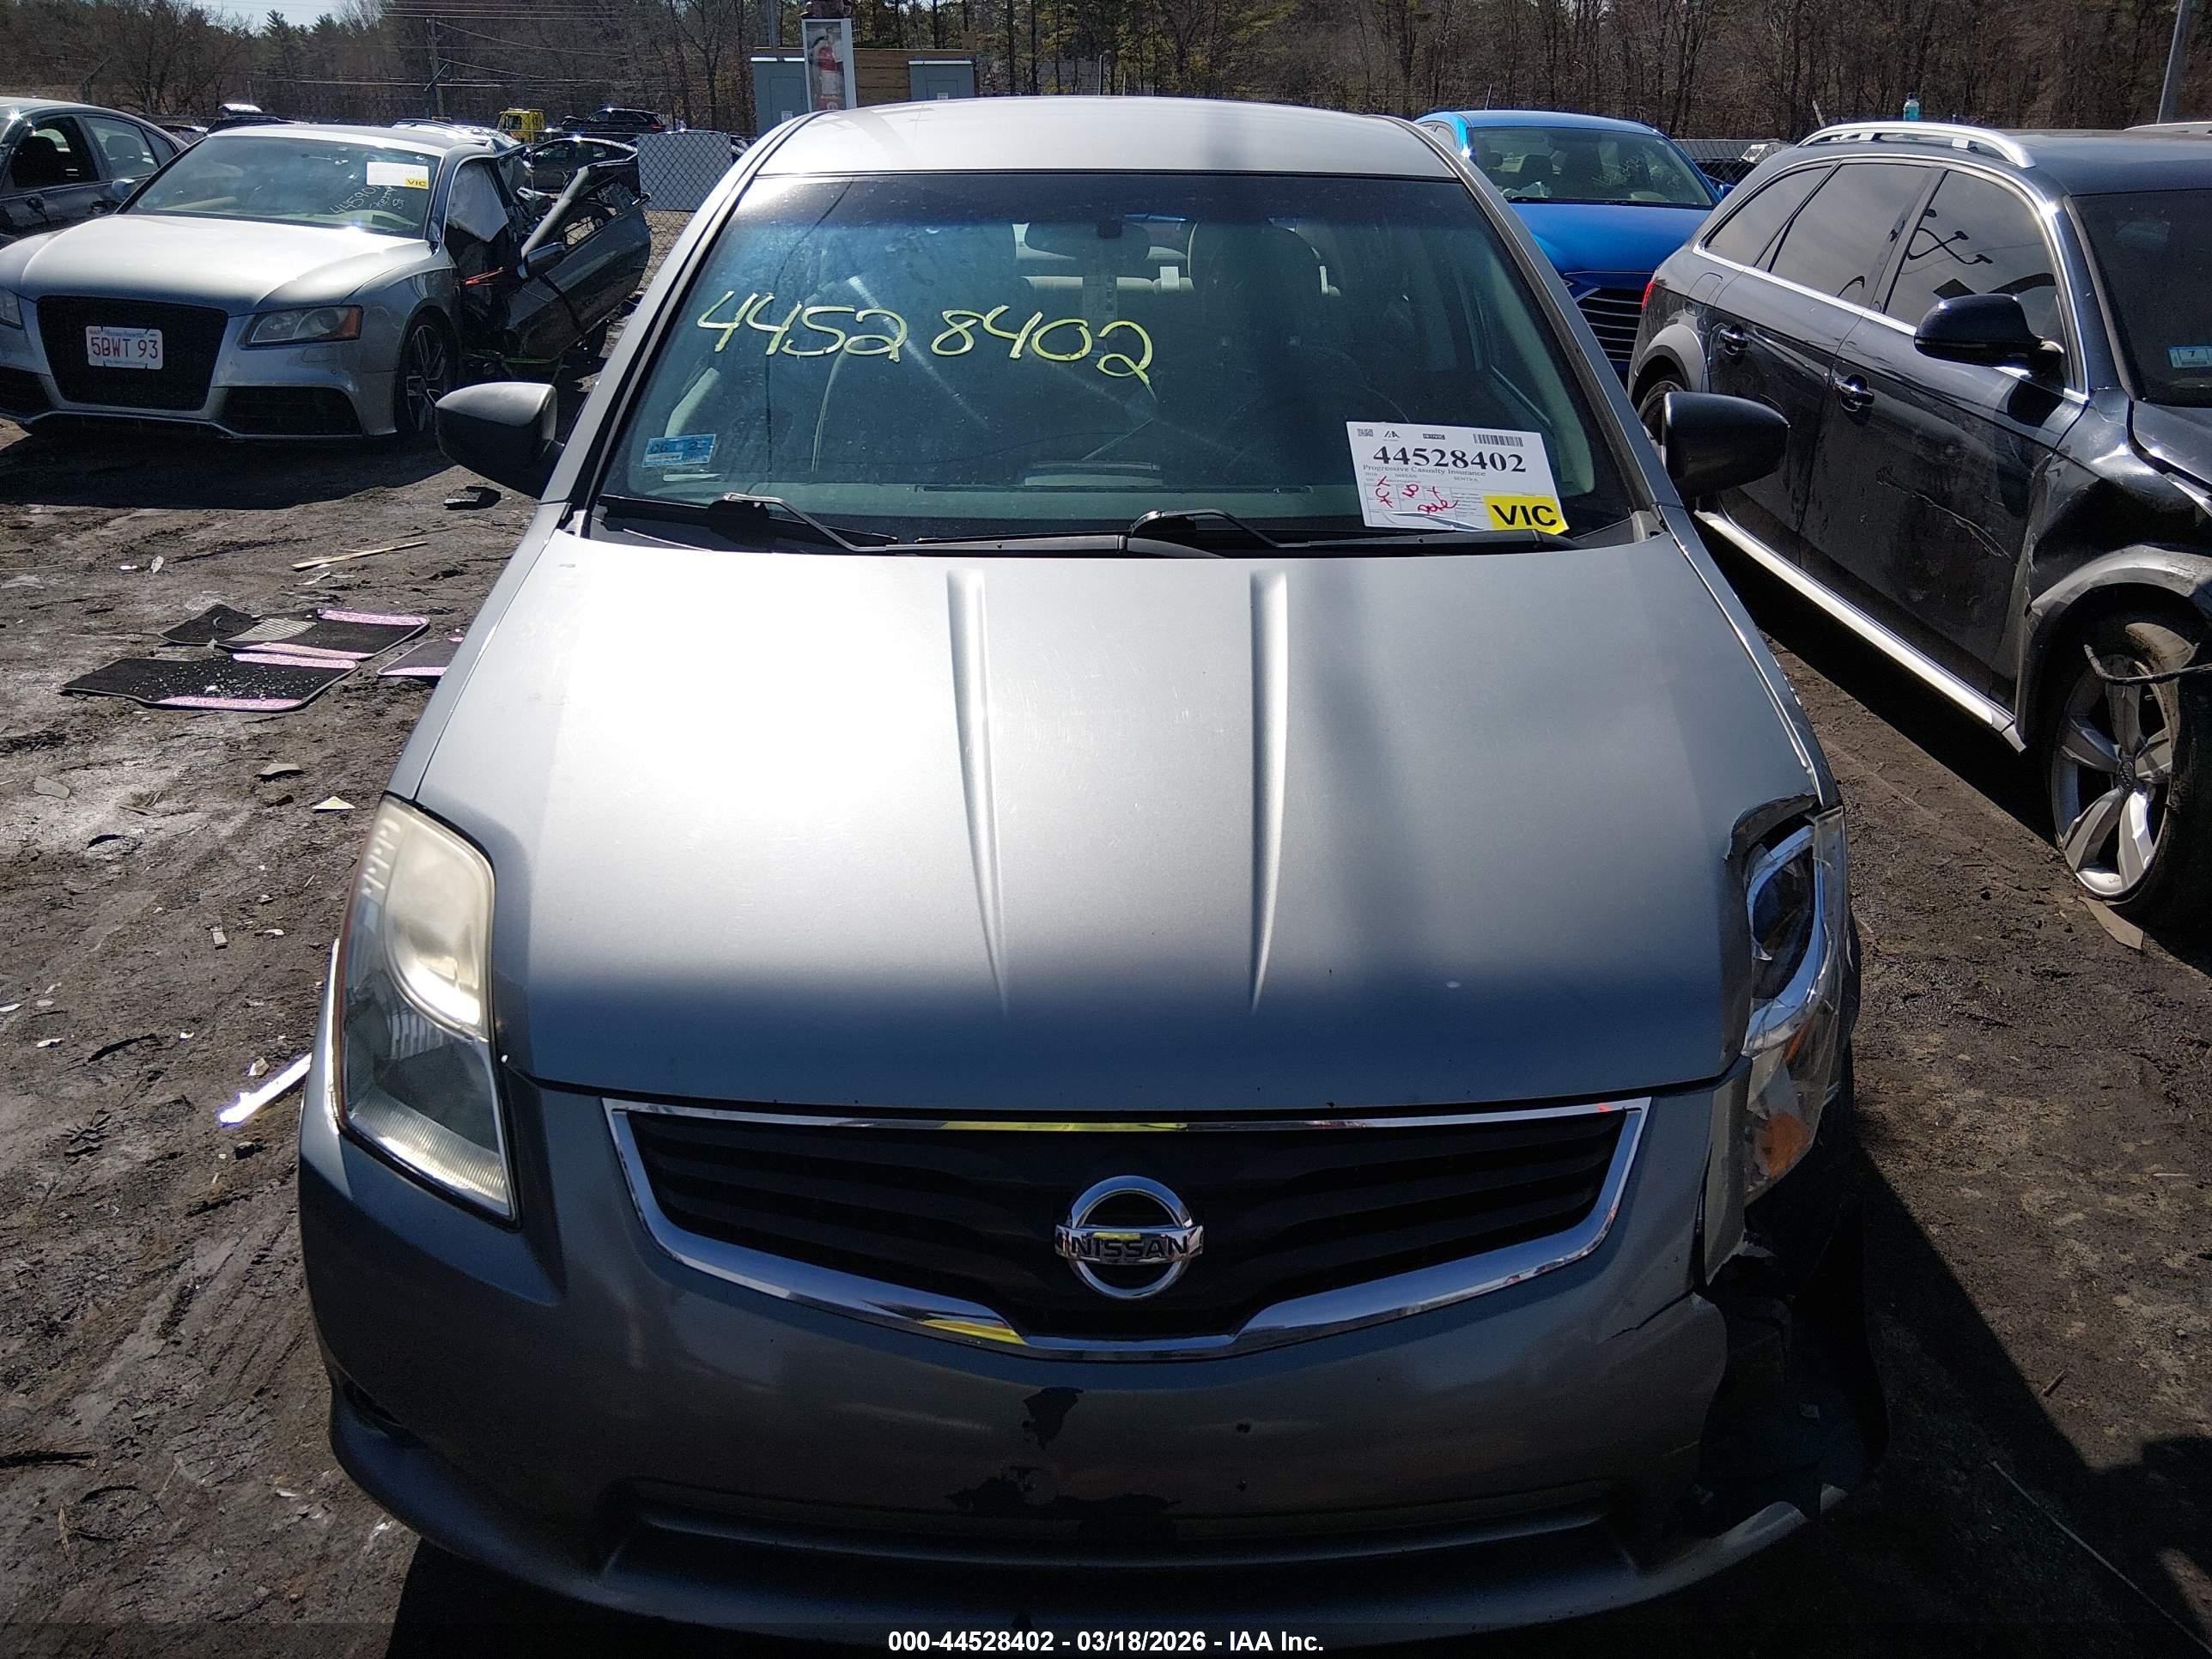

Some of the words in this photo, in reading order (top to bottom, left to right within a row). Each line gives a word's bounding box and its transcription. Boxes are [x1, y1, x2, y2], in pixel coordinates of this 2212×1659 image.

[137, 339, 158, 359] 93
[1373, 446, 1527, 472] 44528402
[1411, 466, 1445, 475] Casualty
[1491, 504, 1558, 526] VIC
[1071, 1232, 1188, 1258] NISSAN
